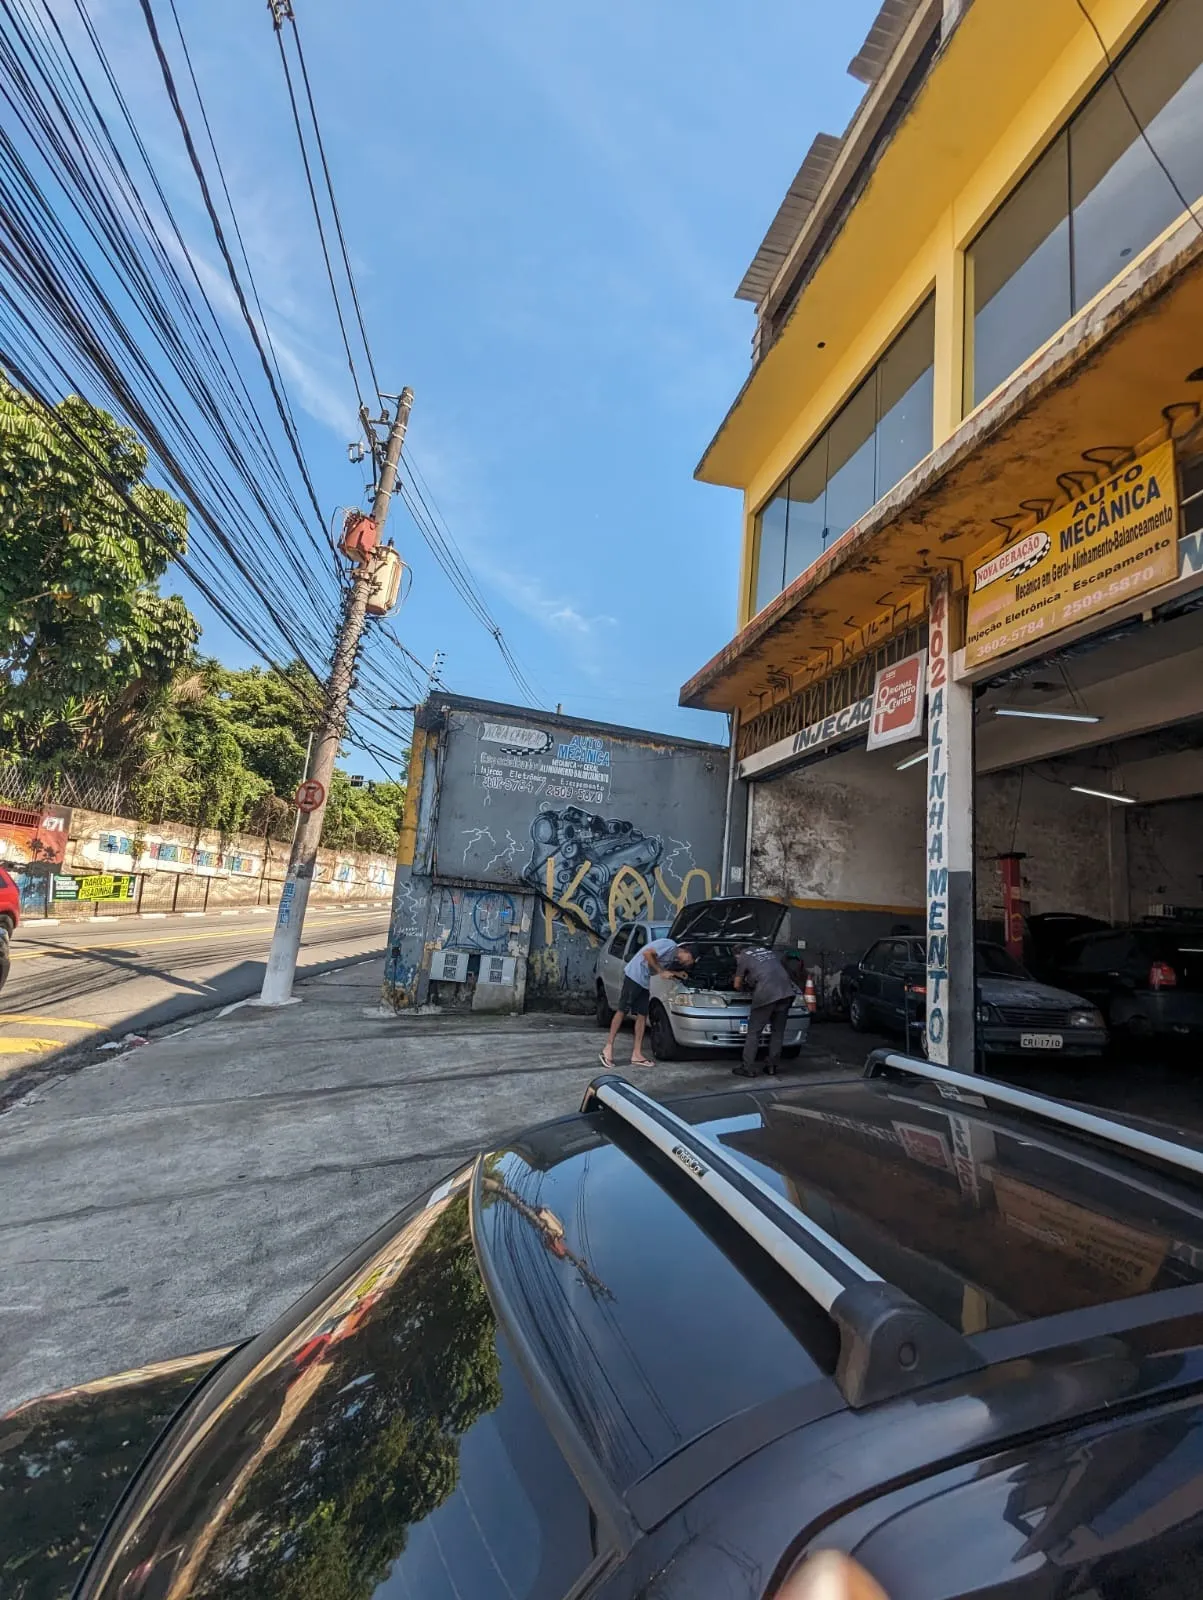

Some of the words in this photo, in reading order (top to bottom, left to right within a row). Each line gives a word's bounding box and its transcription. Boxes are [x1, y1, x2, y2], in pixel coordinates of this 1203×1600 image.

[1059, 476, 1161, 553] MECÂNICA
[1072, 464, 1143, 518] AUTO
[967, 621, 1002, 645] Injeção
[1005, 593, 1061, 625] Eletrônica
[1073, 538, 1170, 591] Escapamento
[977, 562, 999, 585] NOVA
[999, 534, 1040, 570] GERAÇÃO
[1015, 574, 1042, 602] Mecânica
[1041, 573, 1052, 590] em
[930, 595, 947, 688] 402
[977, 617, 1044, 657] 3602-5784
[1063, 567, 1154, 618] 2509-5870
[900, 686, 916, 698] AUTO
[570, 735, 603, 750] AUTO
[928, 688, 948, 1044] ALINHAMENTO
